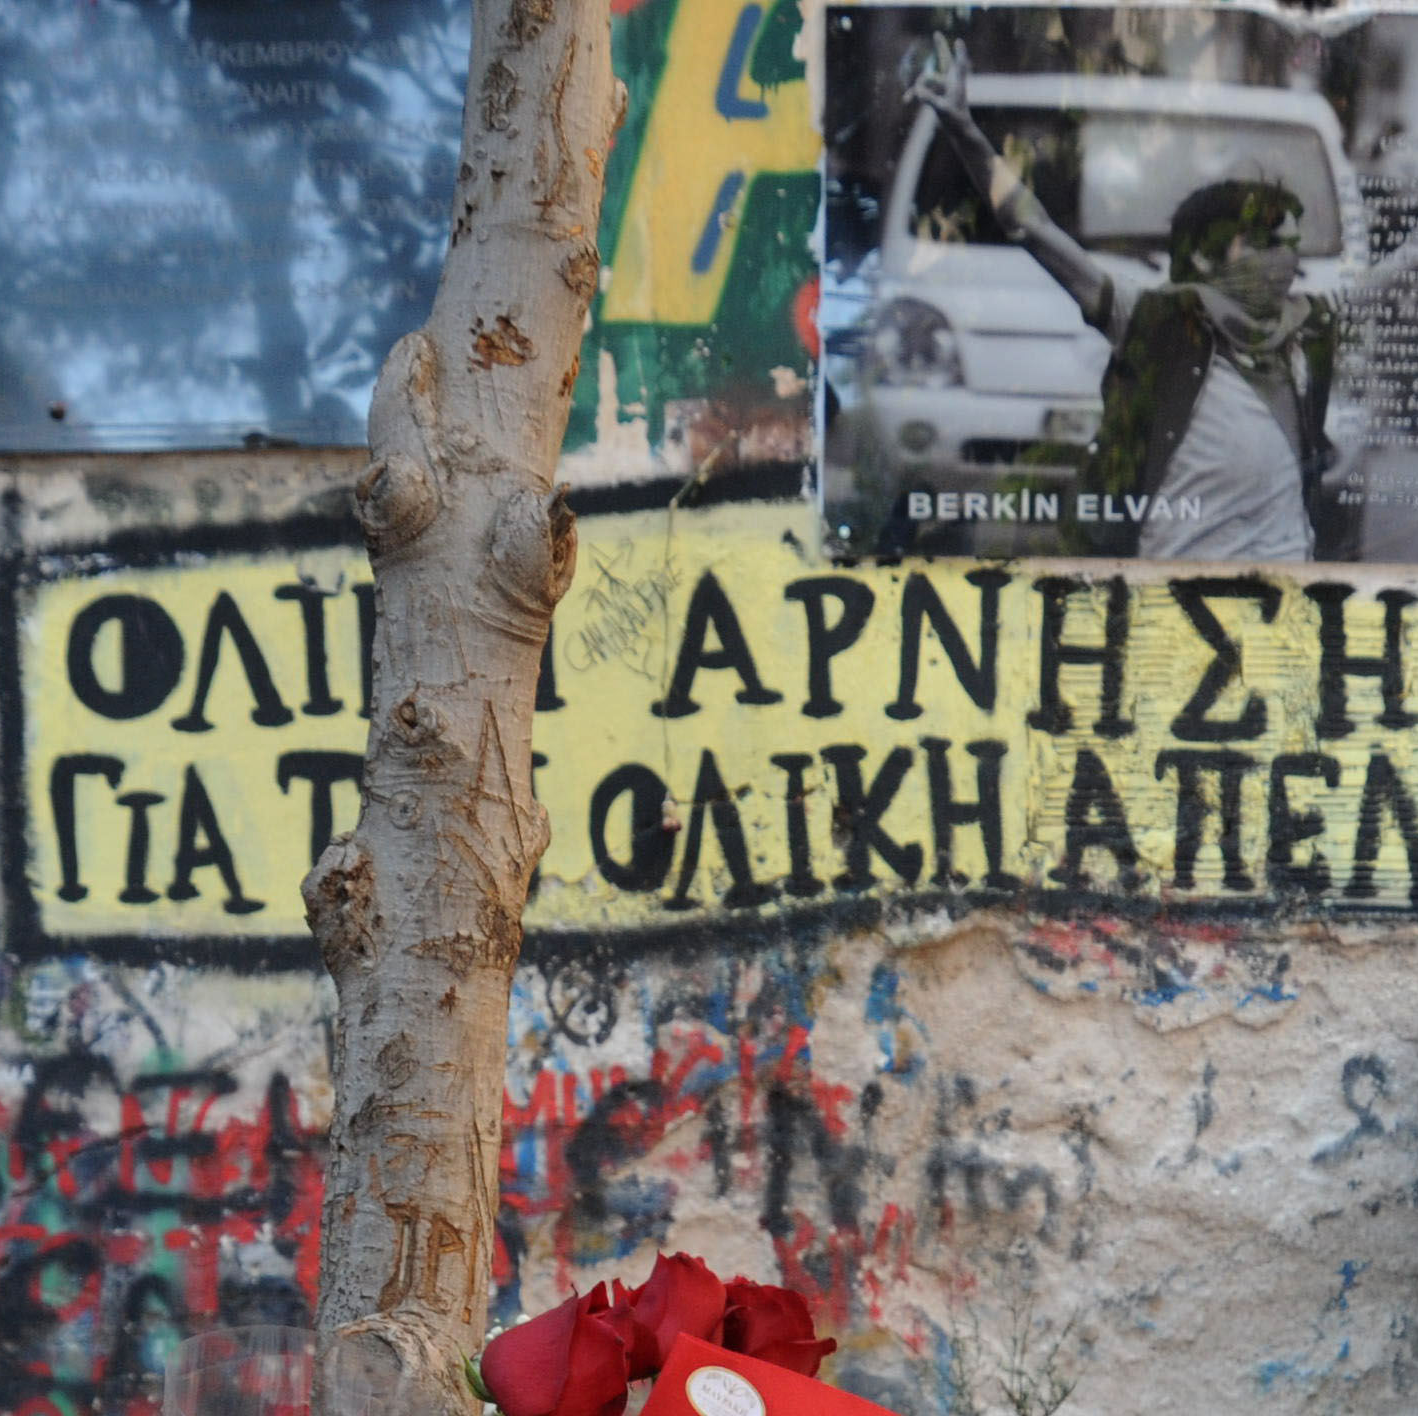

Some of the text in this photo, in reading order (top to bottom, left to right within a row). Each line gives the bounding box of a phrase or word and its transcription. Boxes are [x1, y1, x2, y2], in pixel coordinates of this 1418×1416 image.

[1076, 493, 1202, 522] ELVAN
[49, 752, 266, 915] ΓΙΑ
[589, 735, 1021, 911] ΟΛΙΚΗ
